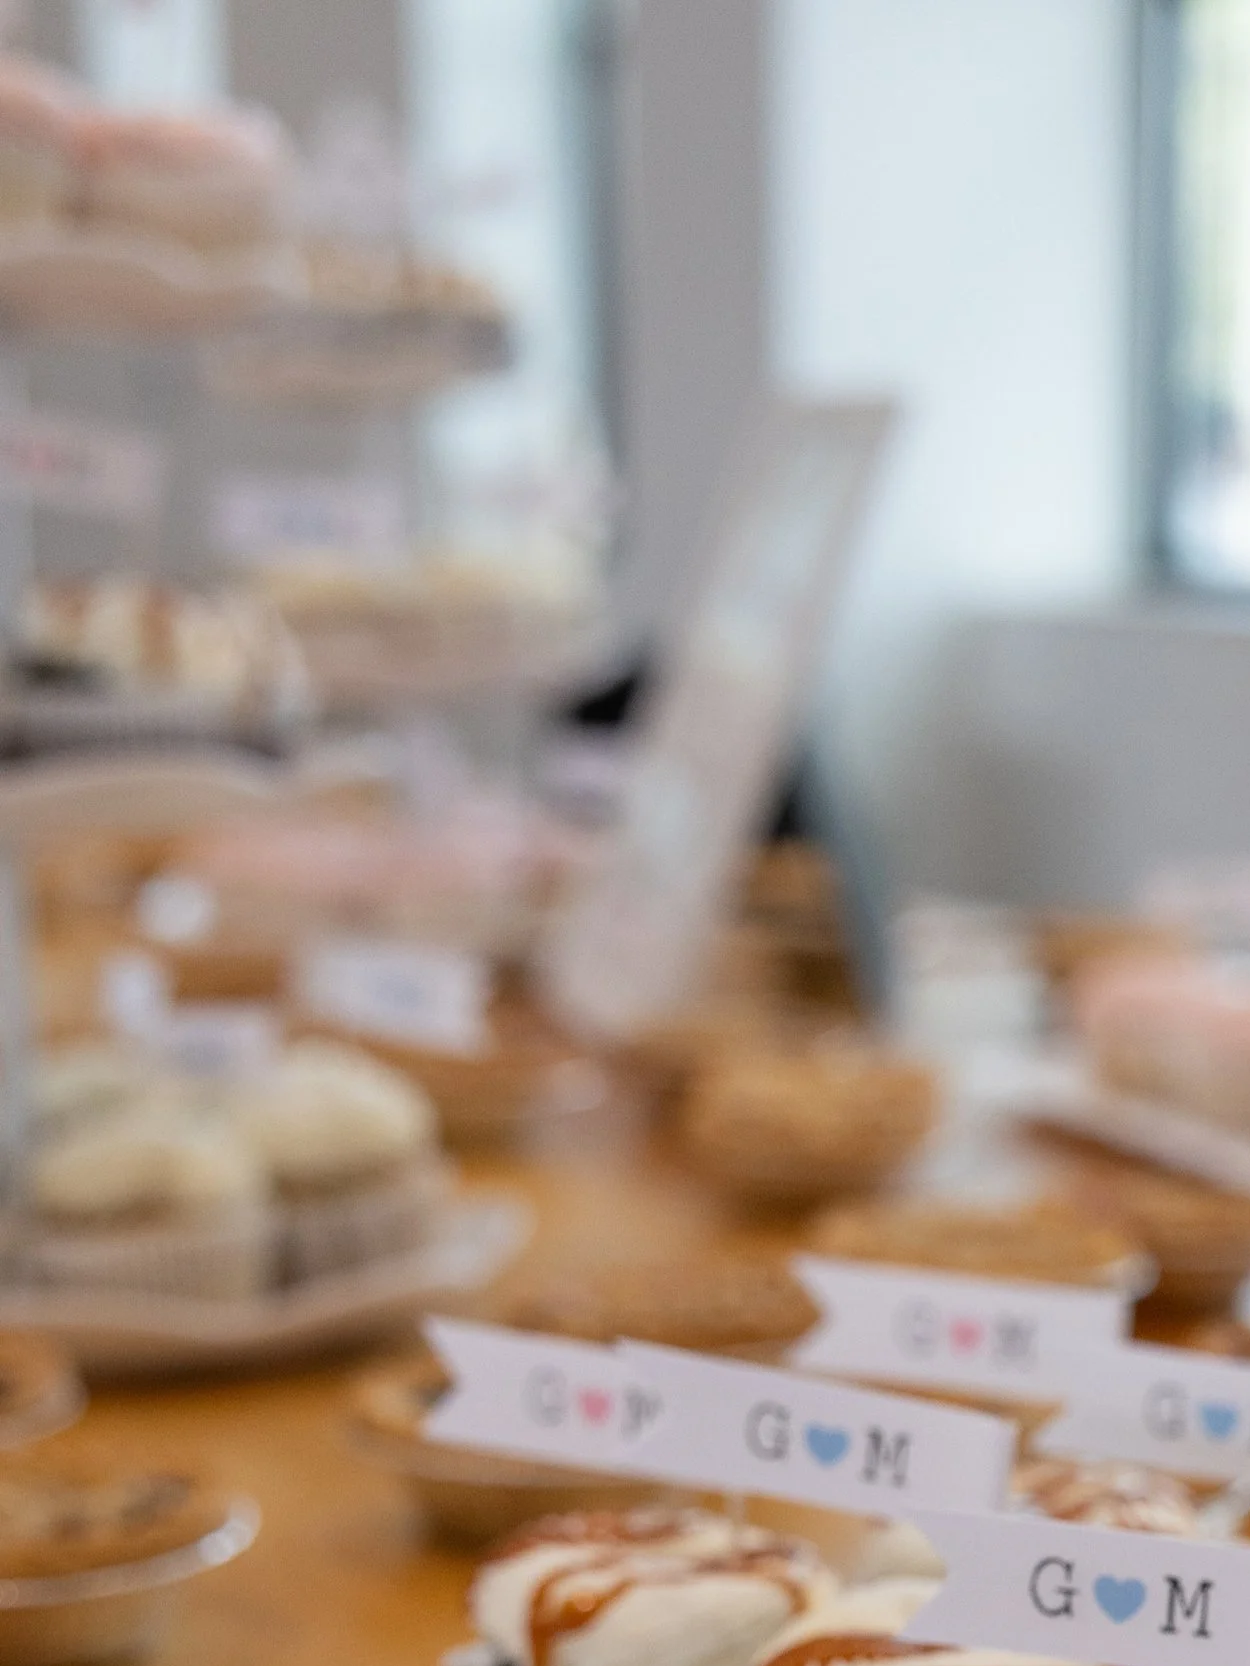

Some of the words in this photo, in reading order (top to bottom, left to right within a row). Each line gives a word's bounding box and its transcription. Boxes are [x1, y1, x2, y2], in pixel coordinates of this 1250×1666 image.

[743, 1399, 792, 1462] G
[860, 1425, 912, 1488] M
[1143, 1383, 1189, 1442] G
[1028, 1556, 1080, 1618] G
[1160, 1575, 1215, 1639] M
